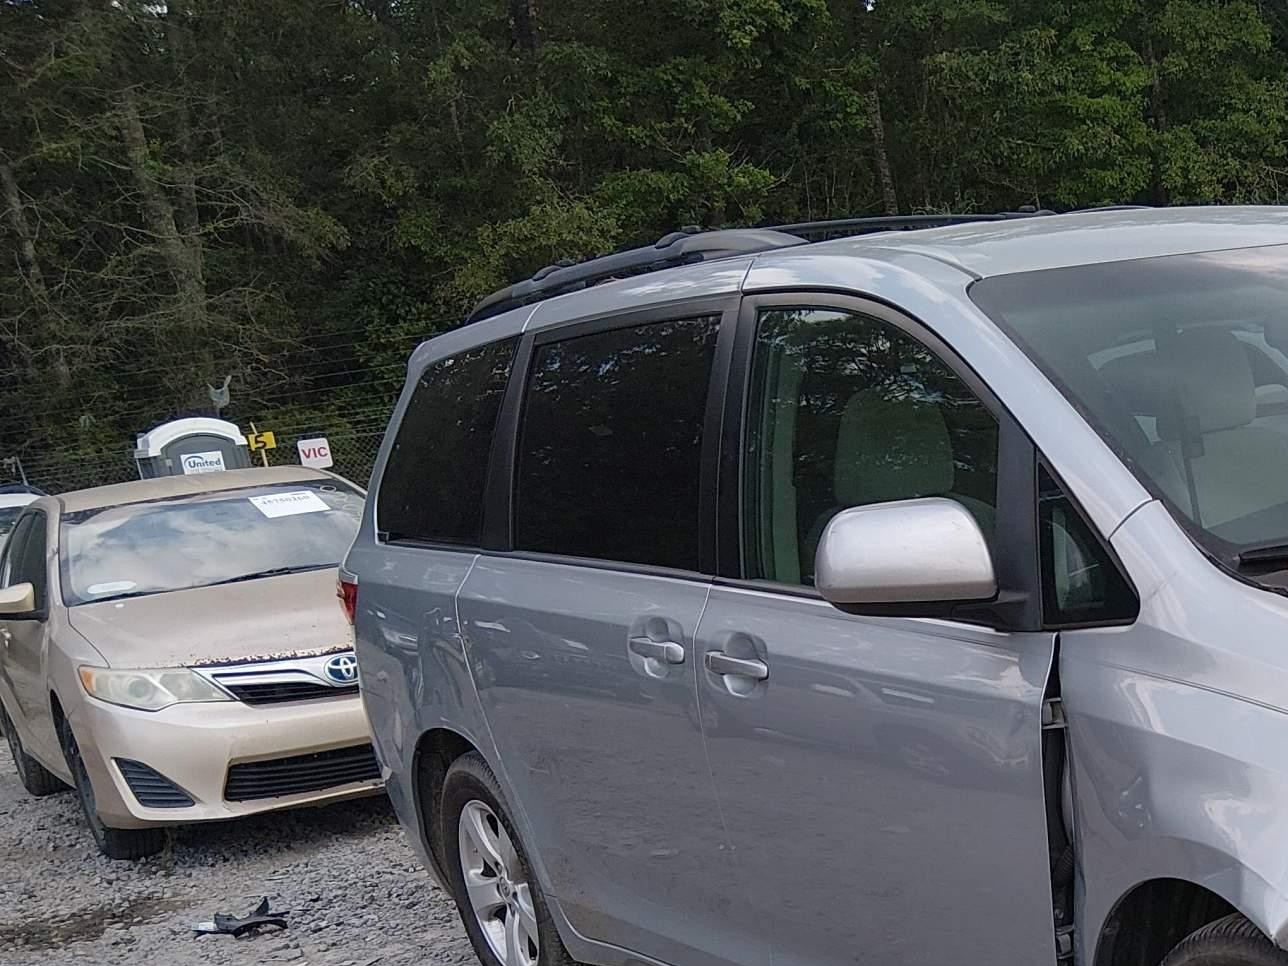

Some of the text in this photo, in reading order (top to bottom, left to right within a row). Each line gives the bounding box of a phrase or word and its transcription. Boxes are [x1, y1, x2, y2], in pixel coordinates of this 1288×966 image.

[254, 433, 267, 450] 5
[300, 446, 328, 459] VIC
[187, 457, 222, 468] United
